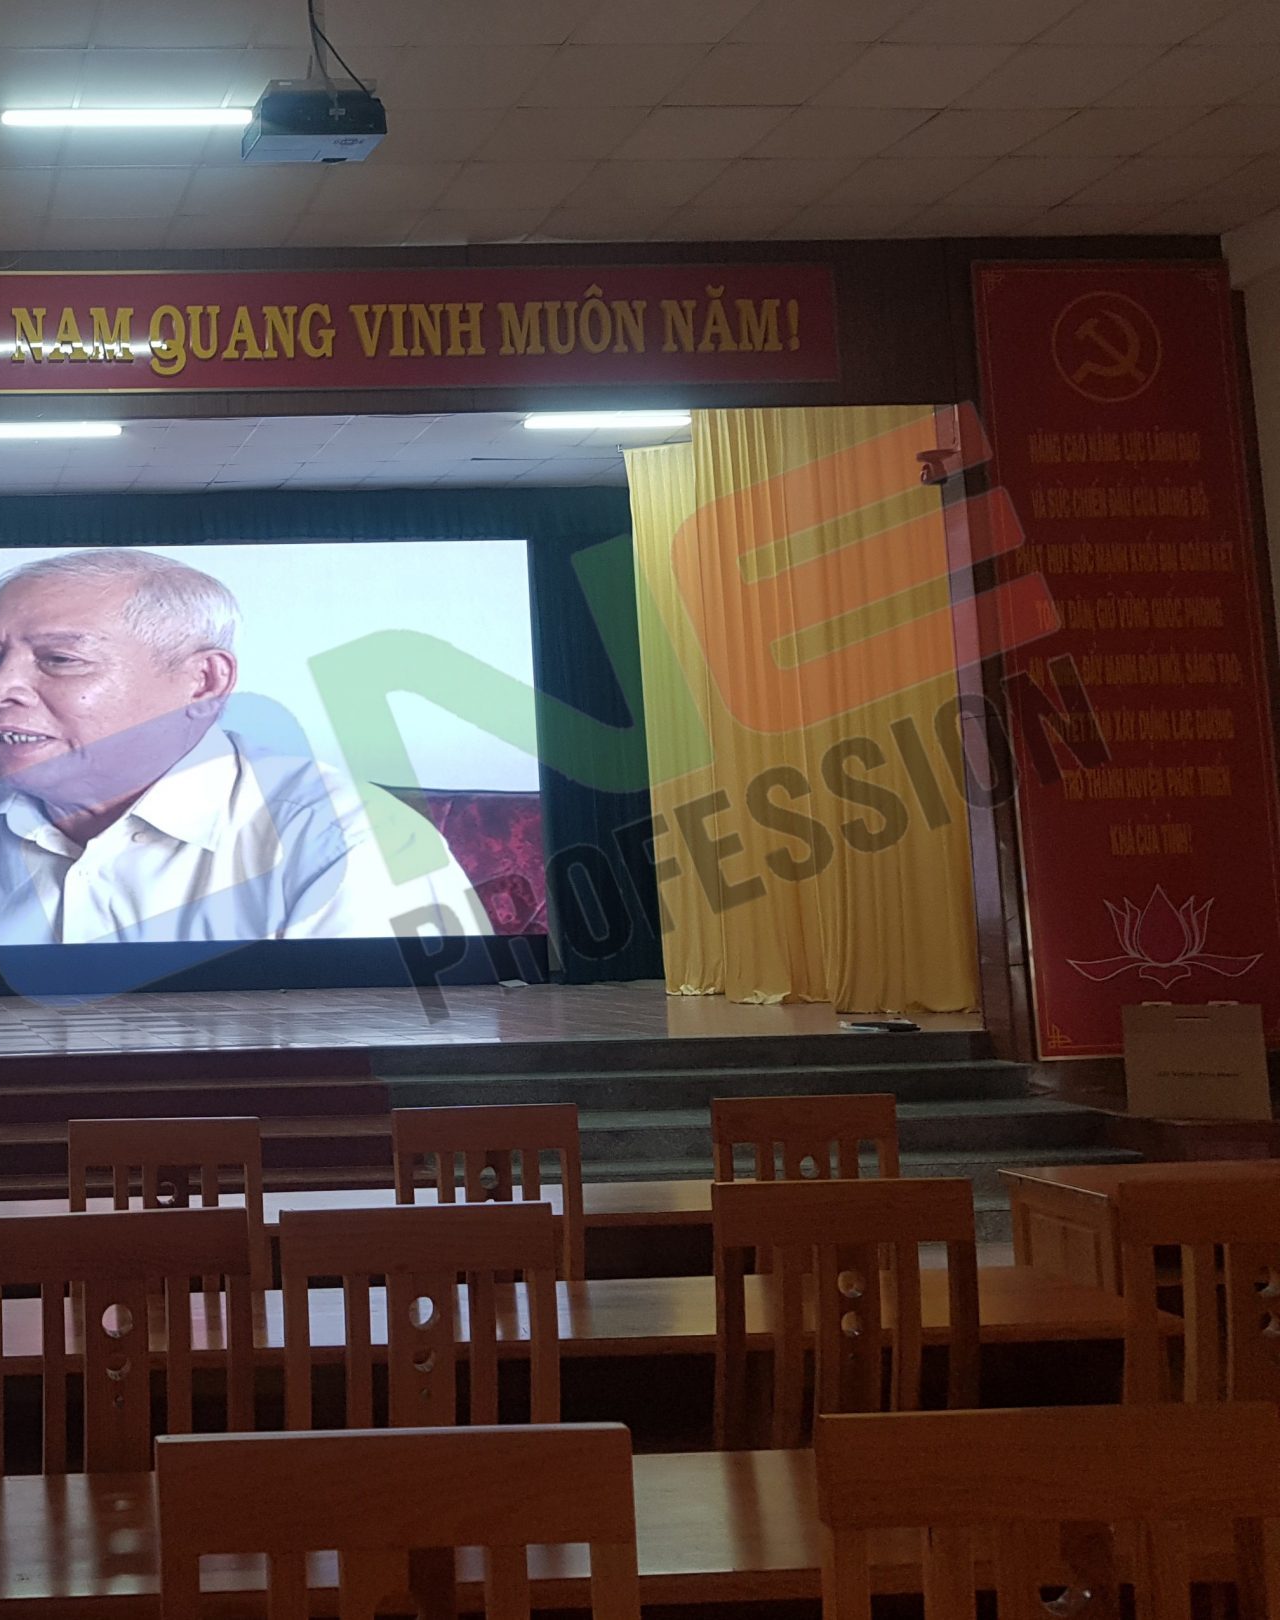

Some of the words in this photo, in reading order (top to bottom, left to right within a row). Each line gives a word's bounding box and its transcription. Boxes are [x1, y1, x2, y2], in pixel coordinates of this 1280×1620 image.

[11, 307, 135, 364] NAM
[149, 303, 336, 376] QUANG
[349, 302, 486, 358] VINH
[497, 283, 647, 357] MUÔN
[661, 284, 801, 354] NĂM!
